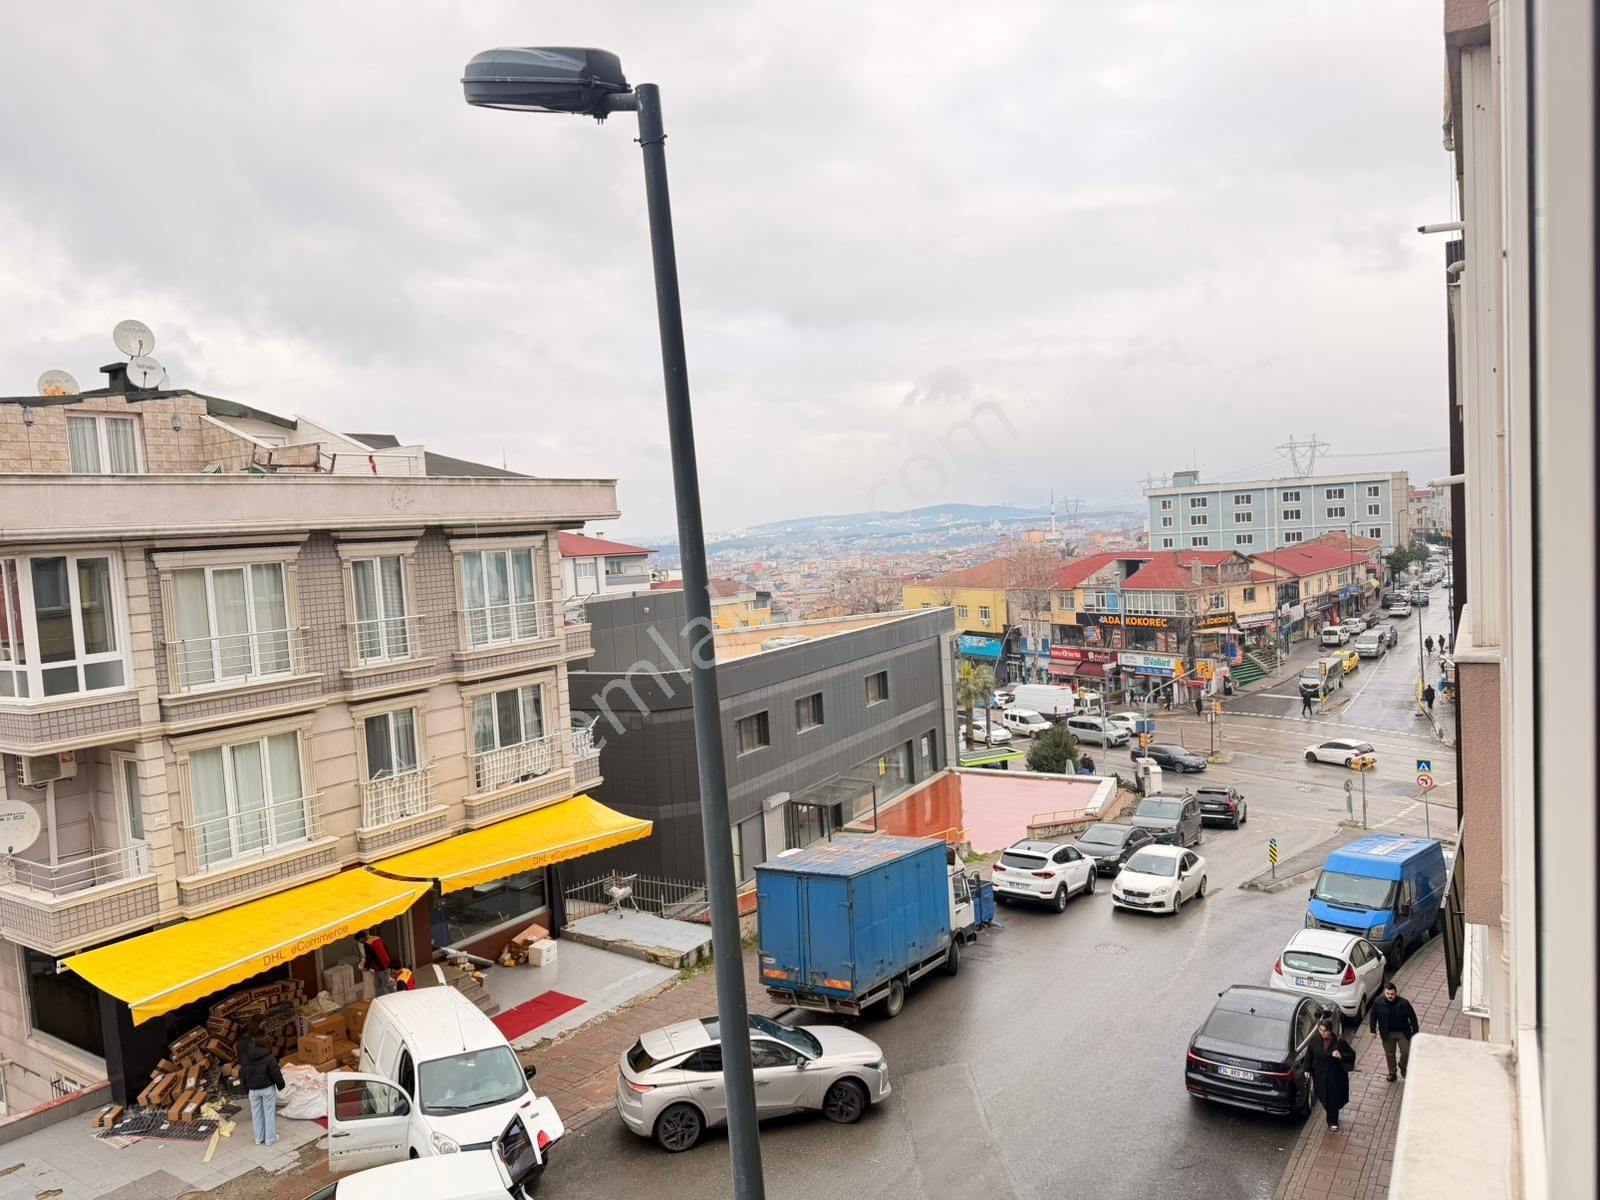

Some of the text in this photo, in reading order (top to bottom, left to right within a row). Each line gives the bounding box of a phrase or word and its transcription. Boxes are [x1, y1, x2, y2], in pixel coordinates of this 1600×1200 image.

[1103, 616, 1120, 625] ADA
[1150, 657, 1171, 667] Vaillant
[533, 845, 589, 865] DHL eCommerce
[263, 925, 349, 966] DHL eCommerce
